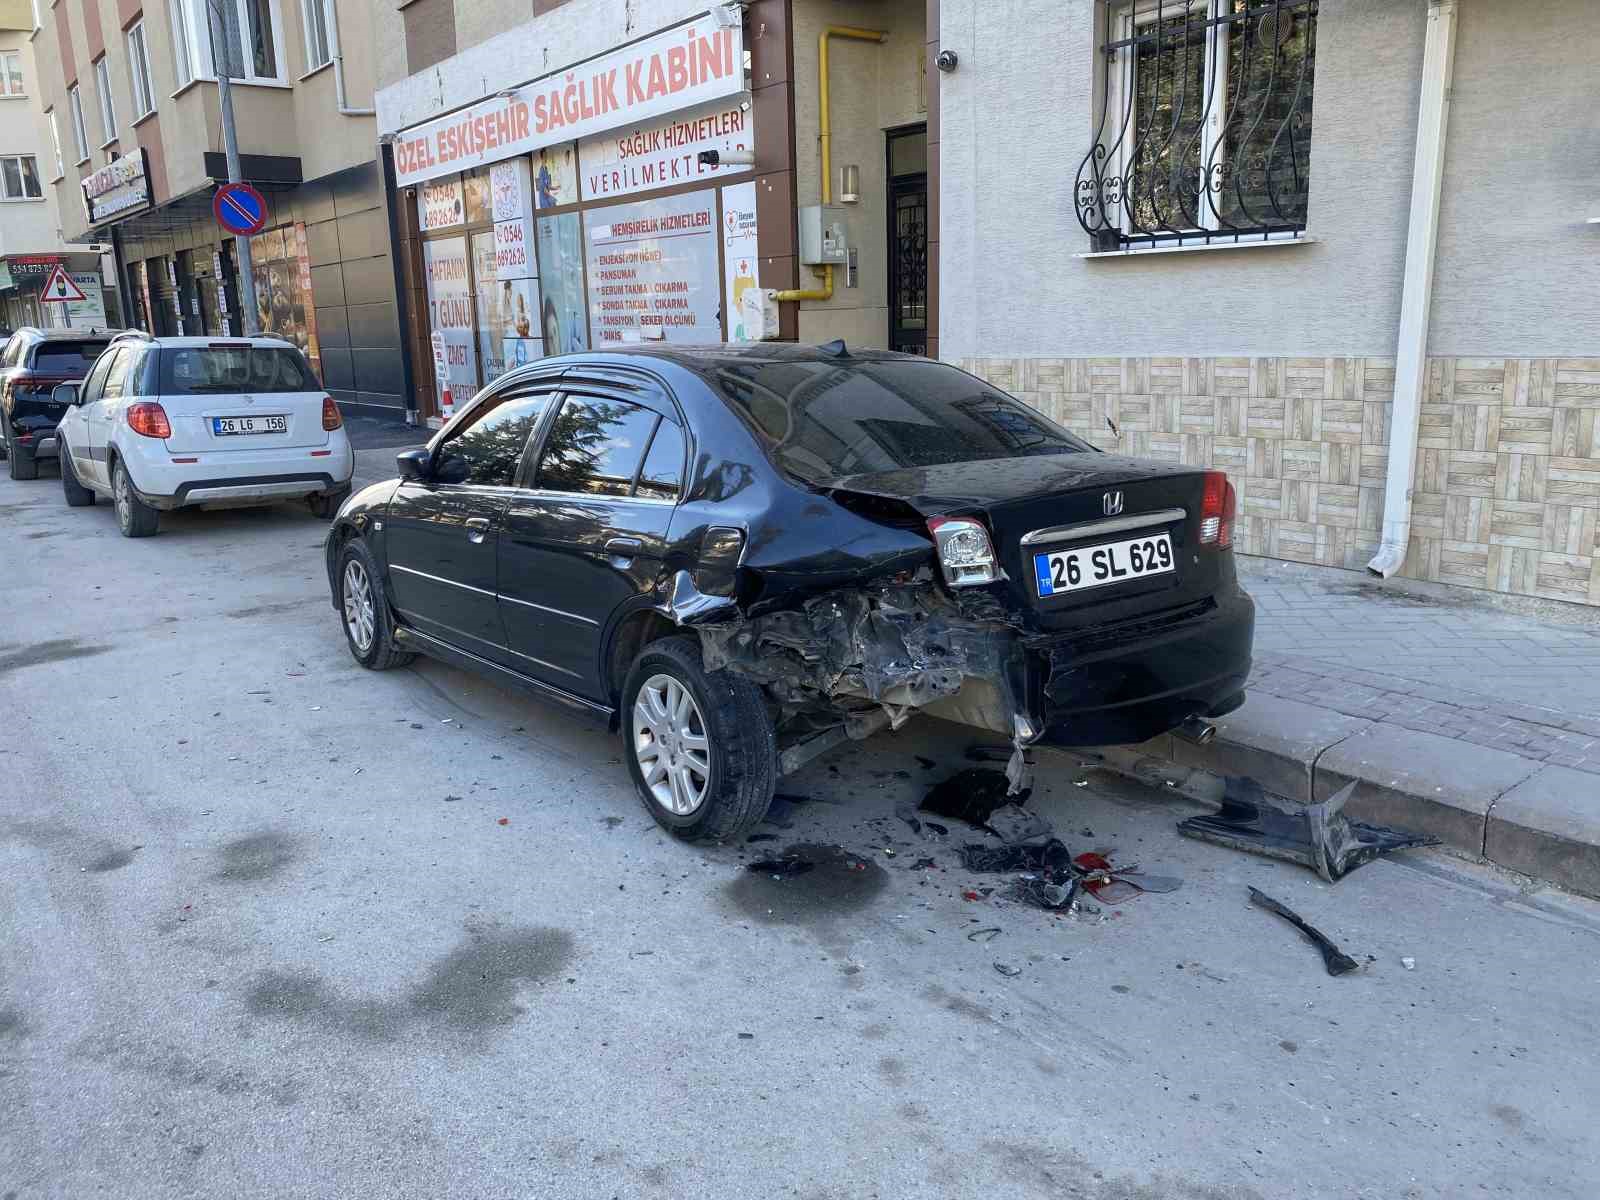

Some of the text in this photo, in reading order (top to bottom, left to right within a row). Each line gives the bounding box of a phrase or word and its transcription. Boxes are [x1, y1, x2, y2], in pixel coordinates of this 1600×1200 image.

[396, 28, 734, 175] ÖZEL ESKİŞEHİR SAĞLIK KABİNİ
[619, 110, 745, 160] SAĞLIK HİZMETLERİ
[660, 207, 711, 231] HİZMETLERİ
[503, 223, 523, 244] 0546
[74, 276, 96, 284] ARTA
[222, 419, 234, 432] 26
[265, 417, 284, 430] 156
[1051, 538, 1171, 589] 26 SL 629
